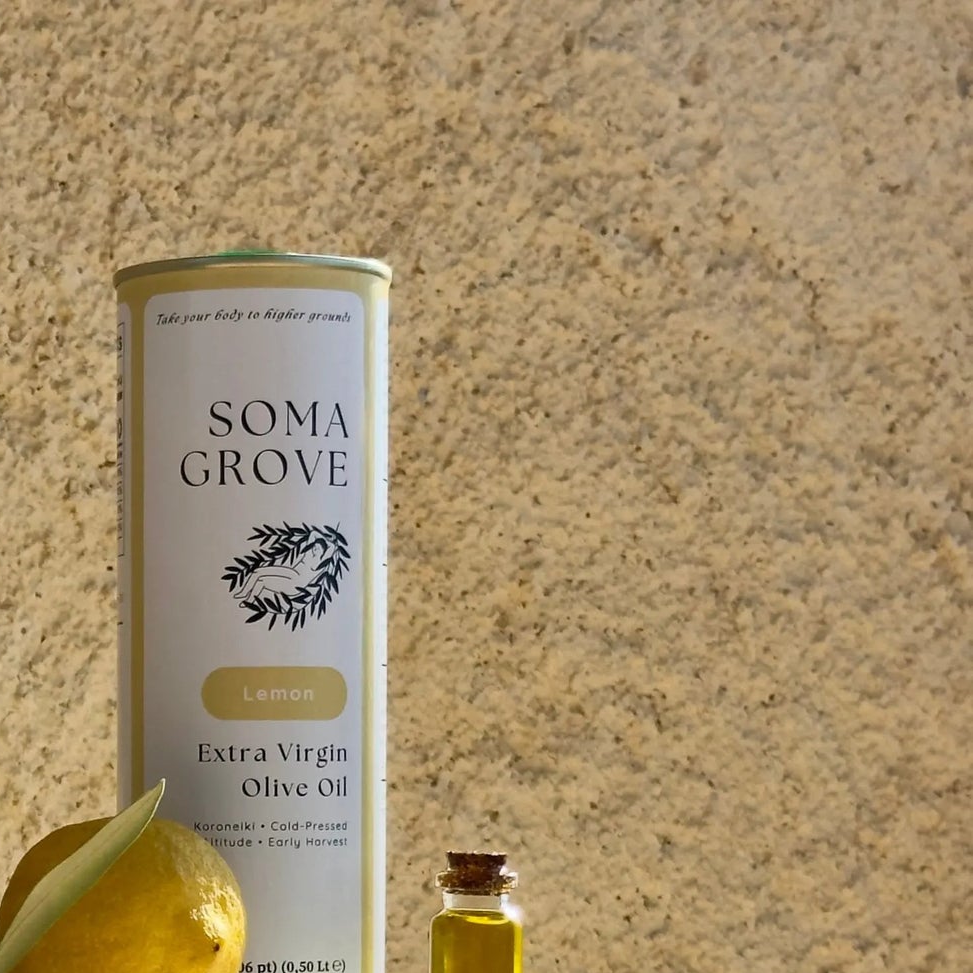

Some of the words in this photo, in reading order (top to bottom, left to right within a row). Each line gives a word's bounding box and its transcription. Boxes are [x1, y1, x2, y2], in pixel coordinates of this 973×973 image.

[156, 313, 179, 325] Take
[182, 311, 211, 325] your
[214, 308, 243, 321] body
[247, 310, 260, 320] to
[263, 308, 305, 323] higher
[308, 312, 352, 323] grounds
[208, 400, 349, 438] SOMA
[180, 449, 348, 487] GROVE
[243, 685, 314, 702] Lemon
[198, 743, 267, 763] Extra
[277, 743, 348, 768] Virgin
[241, 776, 308, 797] Olive
[318, 776, 348, 797] Oil
[193, 821, 255, 832] Koroneiki
[270, 821, 348, 831] Cold-Pressed
[204, 836, 253, 848] ltitude
[268, 837, 301, 849] Early
[306, 837, 348, 847] Harvest
[317, 960, 329, 973] Lt
